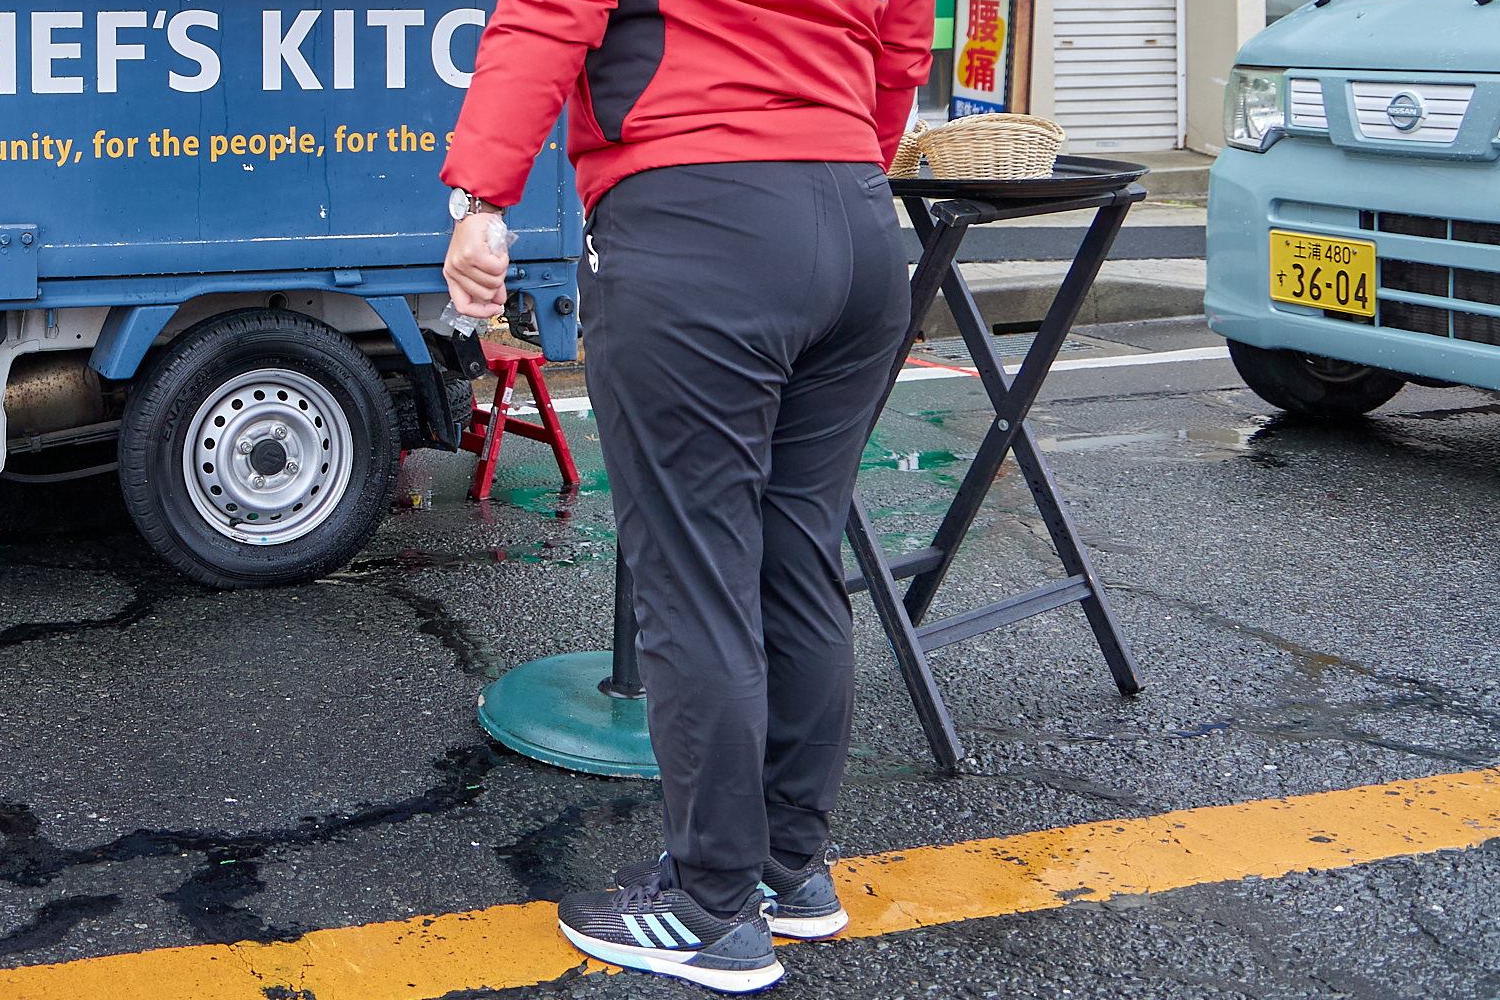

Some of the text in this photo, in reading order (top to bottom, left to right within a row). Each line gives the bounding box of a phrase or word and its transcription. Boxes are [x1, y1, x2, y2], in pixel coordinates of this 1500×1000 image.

[1388, 107, 1417, 115] NISSAN
[93, 129, 138, 158] for
[148, 129, 199, 157] the
[210, 126, 325, 162] people,
[334, 125, 379, 153] for
[388, 125, 435, 152] the
[1294, 241, 1351, 264] 土浦 480
[1292, 263, 1368, 309] 36-04
